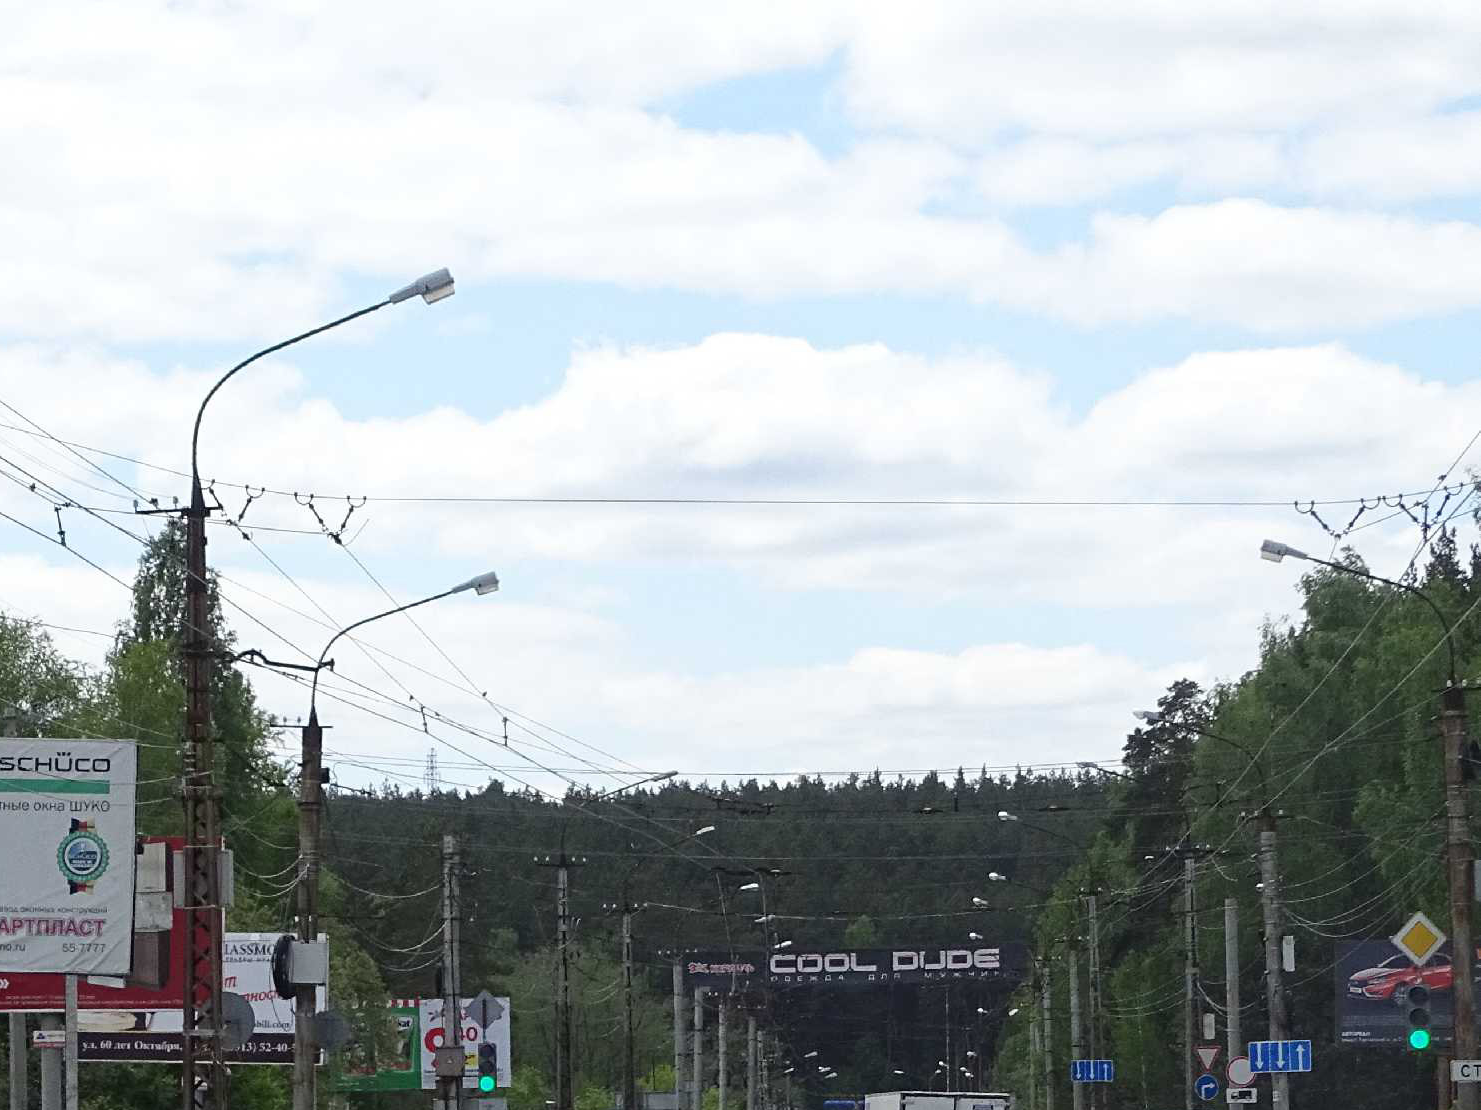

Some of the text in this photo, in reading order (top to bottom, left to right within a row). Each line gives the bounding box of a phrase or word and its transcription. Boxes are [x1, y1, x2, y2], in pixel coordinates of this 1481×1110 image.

[0, 752, 111, 773] SCHÜCO
[33, 801, 65, 811] окна
[69, 800, 111, 812] ШУКО
[769, 953, 877, 973] COOL
[892, 948, 1000, 971] DUDE
[100, 1040, 112, 1050] 60
[114, 1041, 131, 1050] лет
